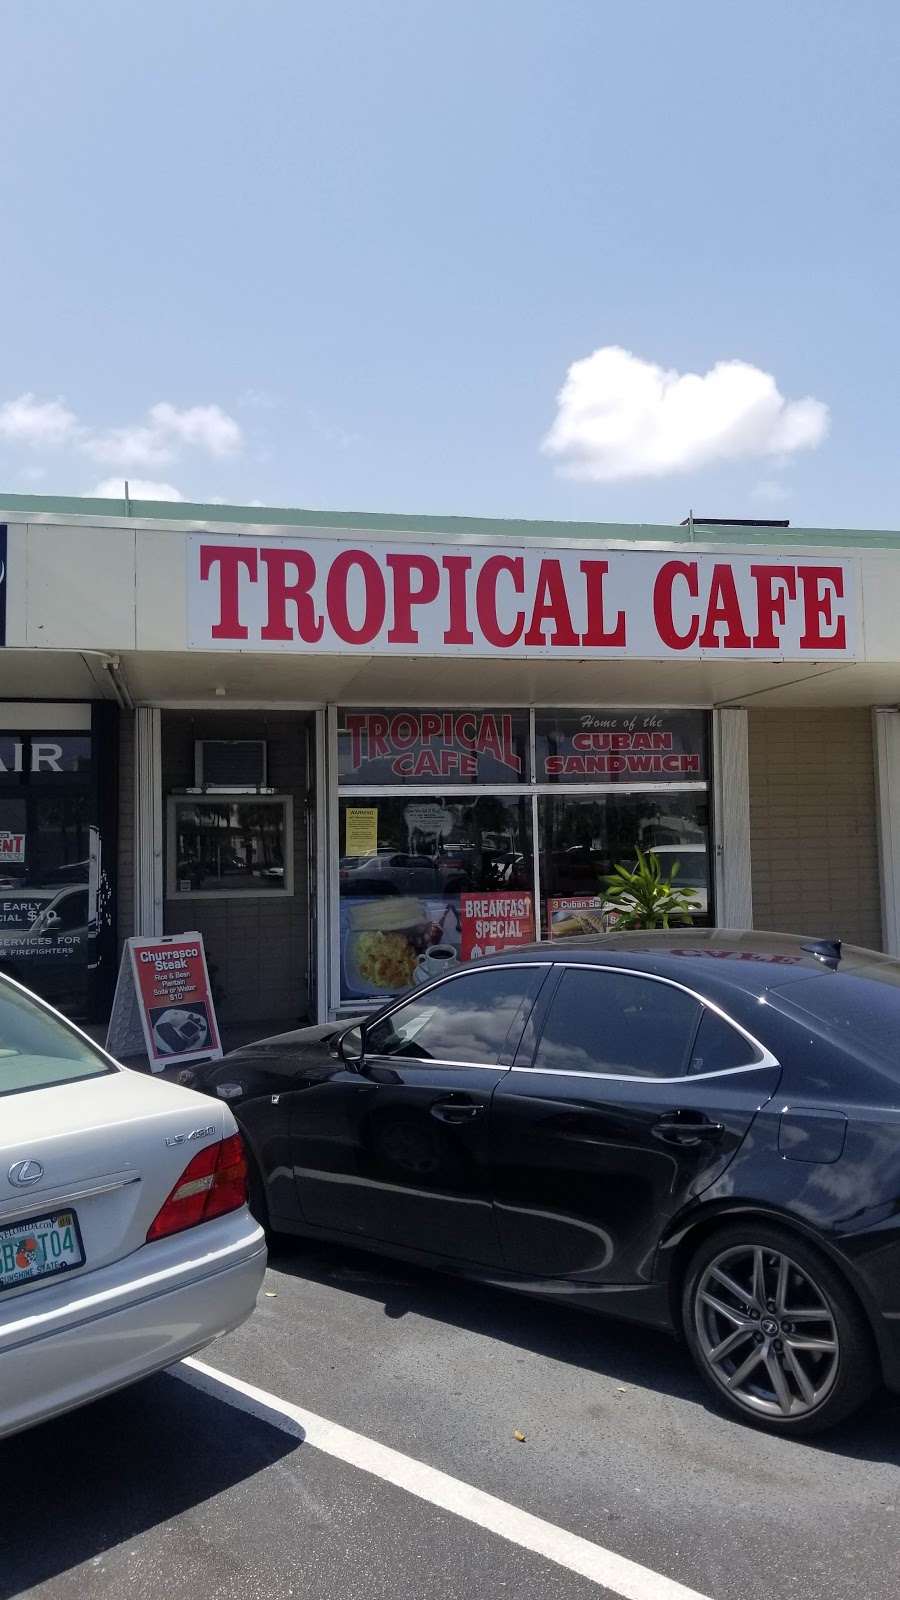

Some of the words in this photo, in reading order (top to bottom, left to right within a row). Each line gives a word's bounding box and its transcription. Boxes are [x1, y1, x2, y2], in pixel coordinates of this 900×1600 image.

[200, 545, 626, 648] TROPICAL
[654, 560, 847, 651] CAFE
[580, 714, 617, 728] Home
[623, 716, 637, 731] of
[643, 714, 663, 728] the
[345, 713, 521, 774] TROPICAL
[572, 732, 672, 751] CUBAN
[392, 750, 478, 776] CAFE
[545, 754, 700, 774] SANDWICH
[3, 902, 42, 911] EARLY
[465, 898, 531, 918] BREAKFAST
[552, 901, 559, 909] 3
[561, 900, 587, 908] Cuban
[27, 909, 57, 922] $10
[475, 920, 523, 939] SPECIAL
[57, 936, 81, 945] FOR
[10, 947, 74, 956] FIREFIGHTERS
[140, 949, 198, 962] Churrasco
[155, 958, 188, 971] Steak
[153, 988, 169, 996] Soda
[169, 993, 183, 1001] $10
[165, 1133, 186, 1147] LS
[37, 1261, 58, 1274] STATE
